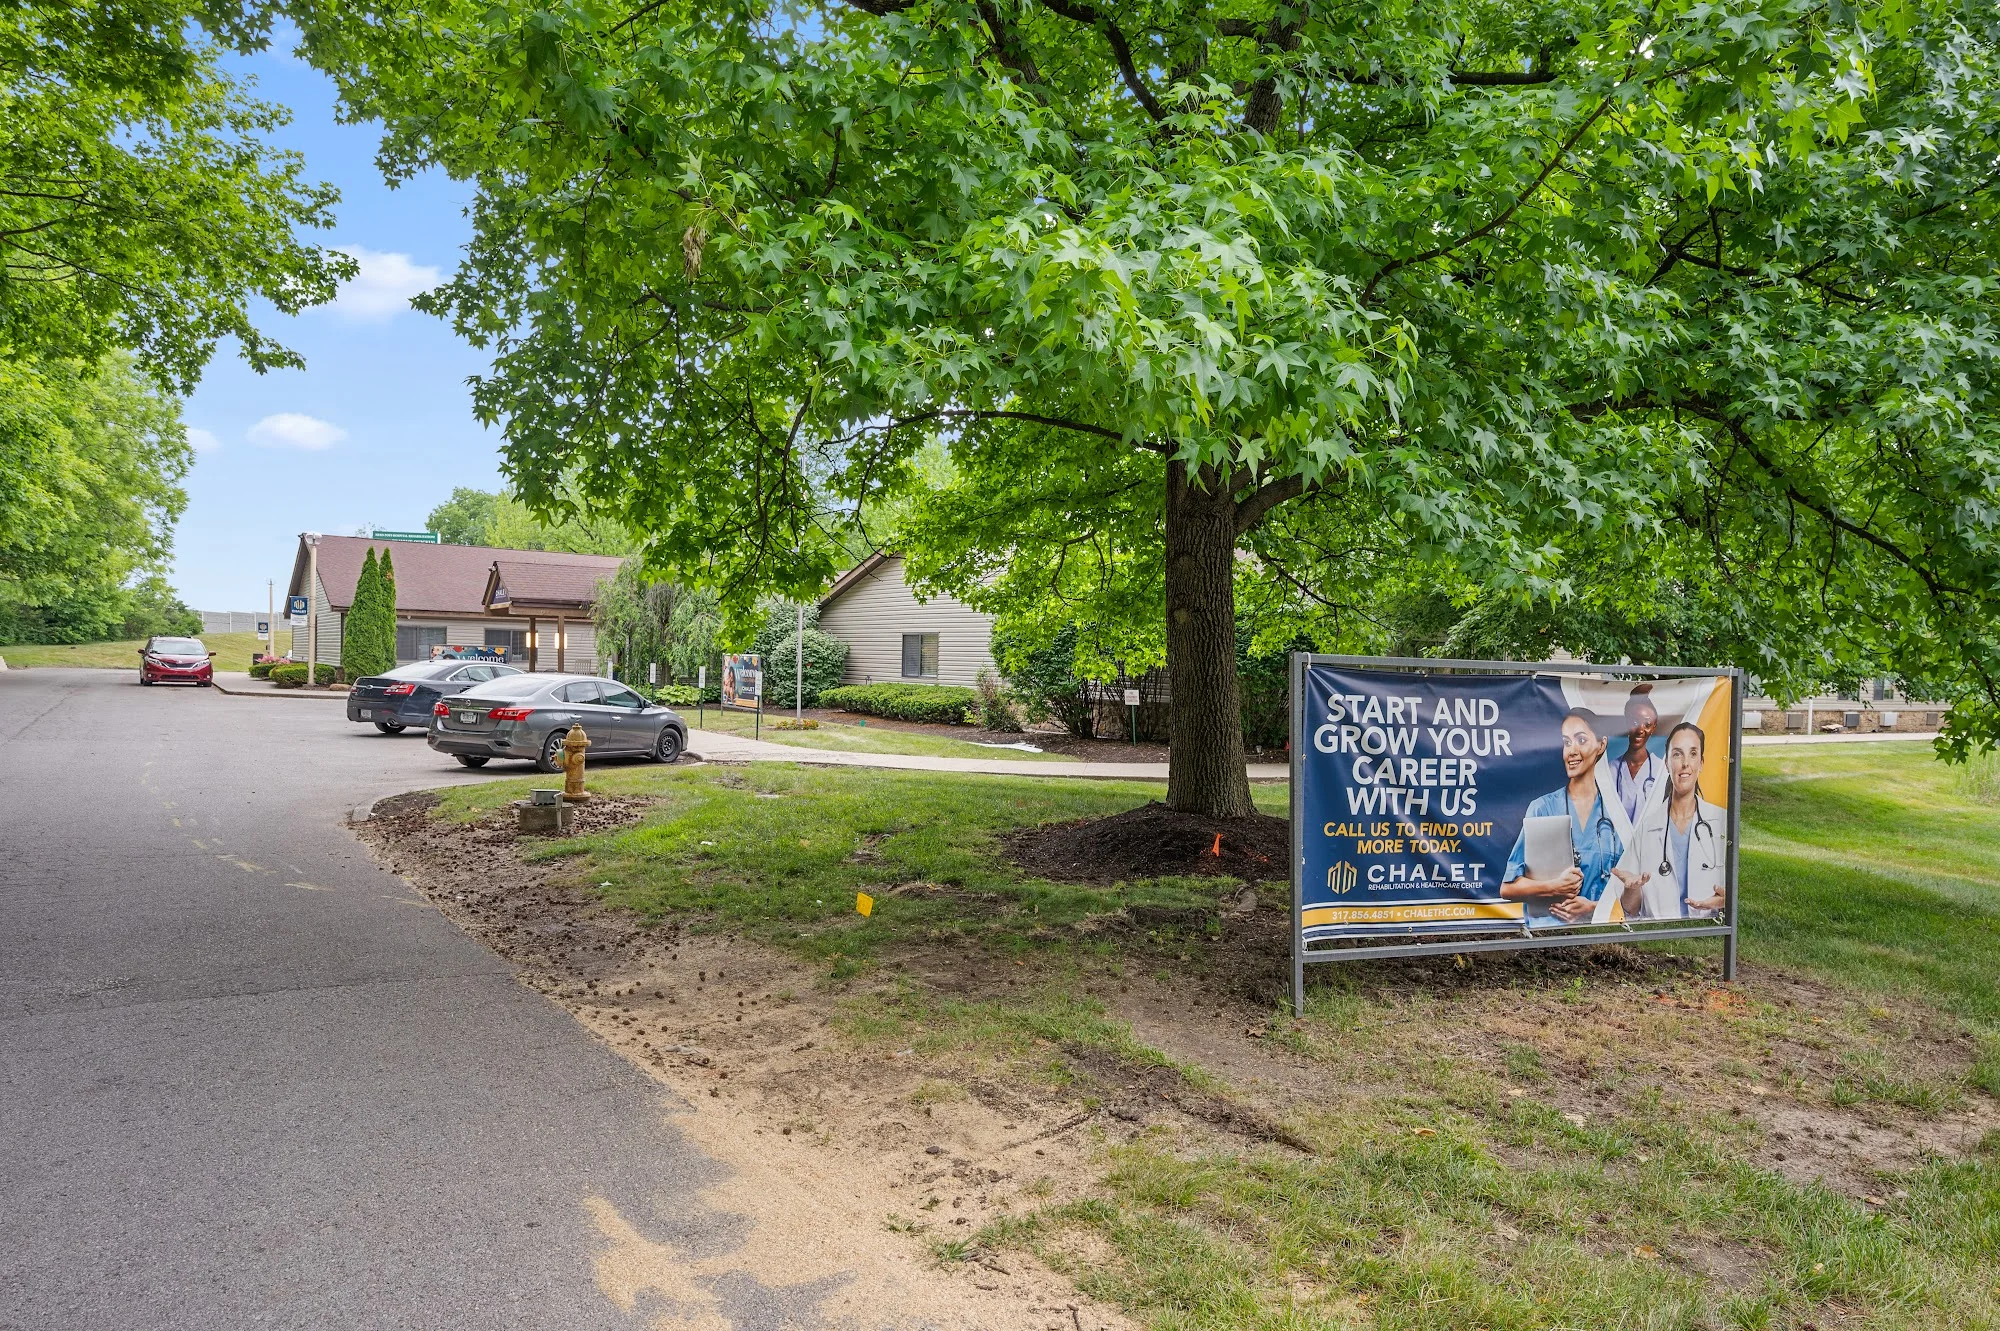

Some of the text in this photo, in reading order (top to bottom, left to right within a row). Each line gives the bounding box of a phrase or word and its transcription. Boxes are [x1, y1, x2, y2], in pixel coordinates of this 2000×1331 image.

[1326, 693, 1499, 726] START AND
[1313, 724, 1513, 756] GROW YOUR
[1352, 755, 1478, 786] CAREER
[1346, 787, 1478, 816] WITH US
[1323, 822, 1493, 837] CALL US TO FIND OUT
[1357, 839, 1462, 854] MORE TODAY.
[1367, 863, 1486, 883] CHALET
[1368, 882, 1415, 891] REHABILITATION
[1461, 881, 1483, 889] CENTER
[1332, 907, 1475, 920] 317.856.4851 CHALETHC.COM
